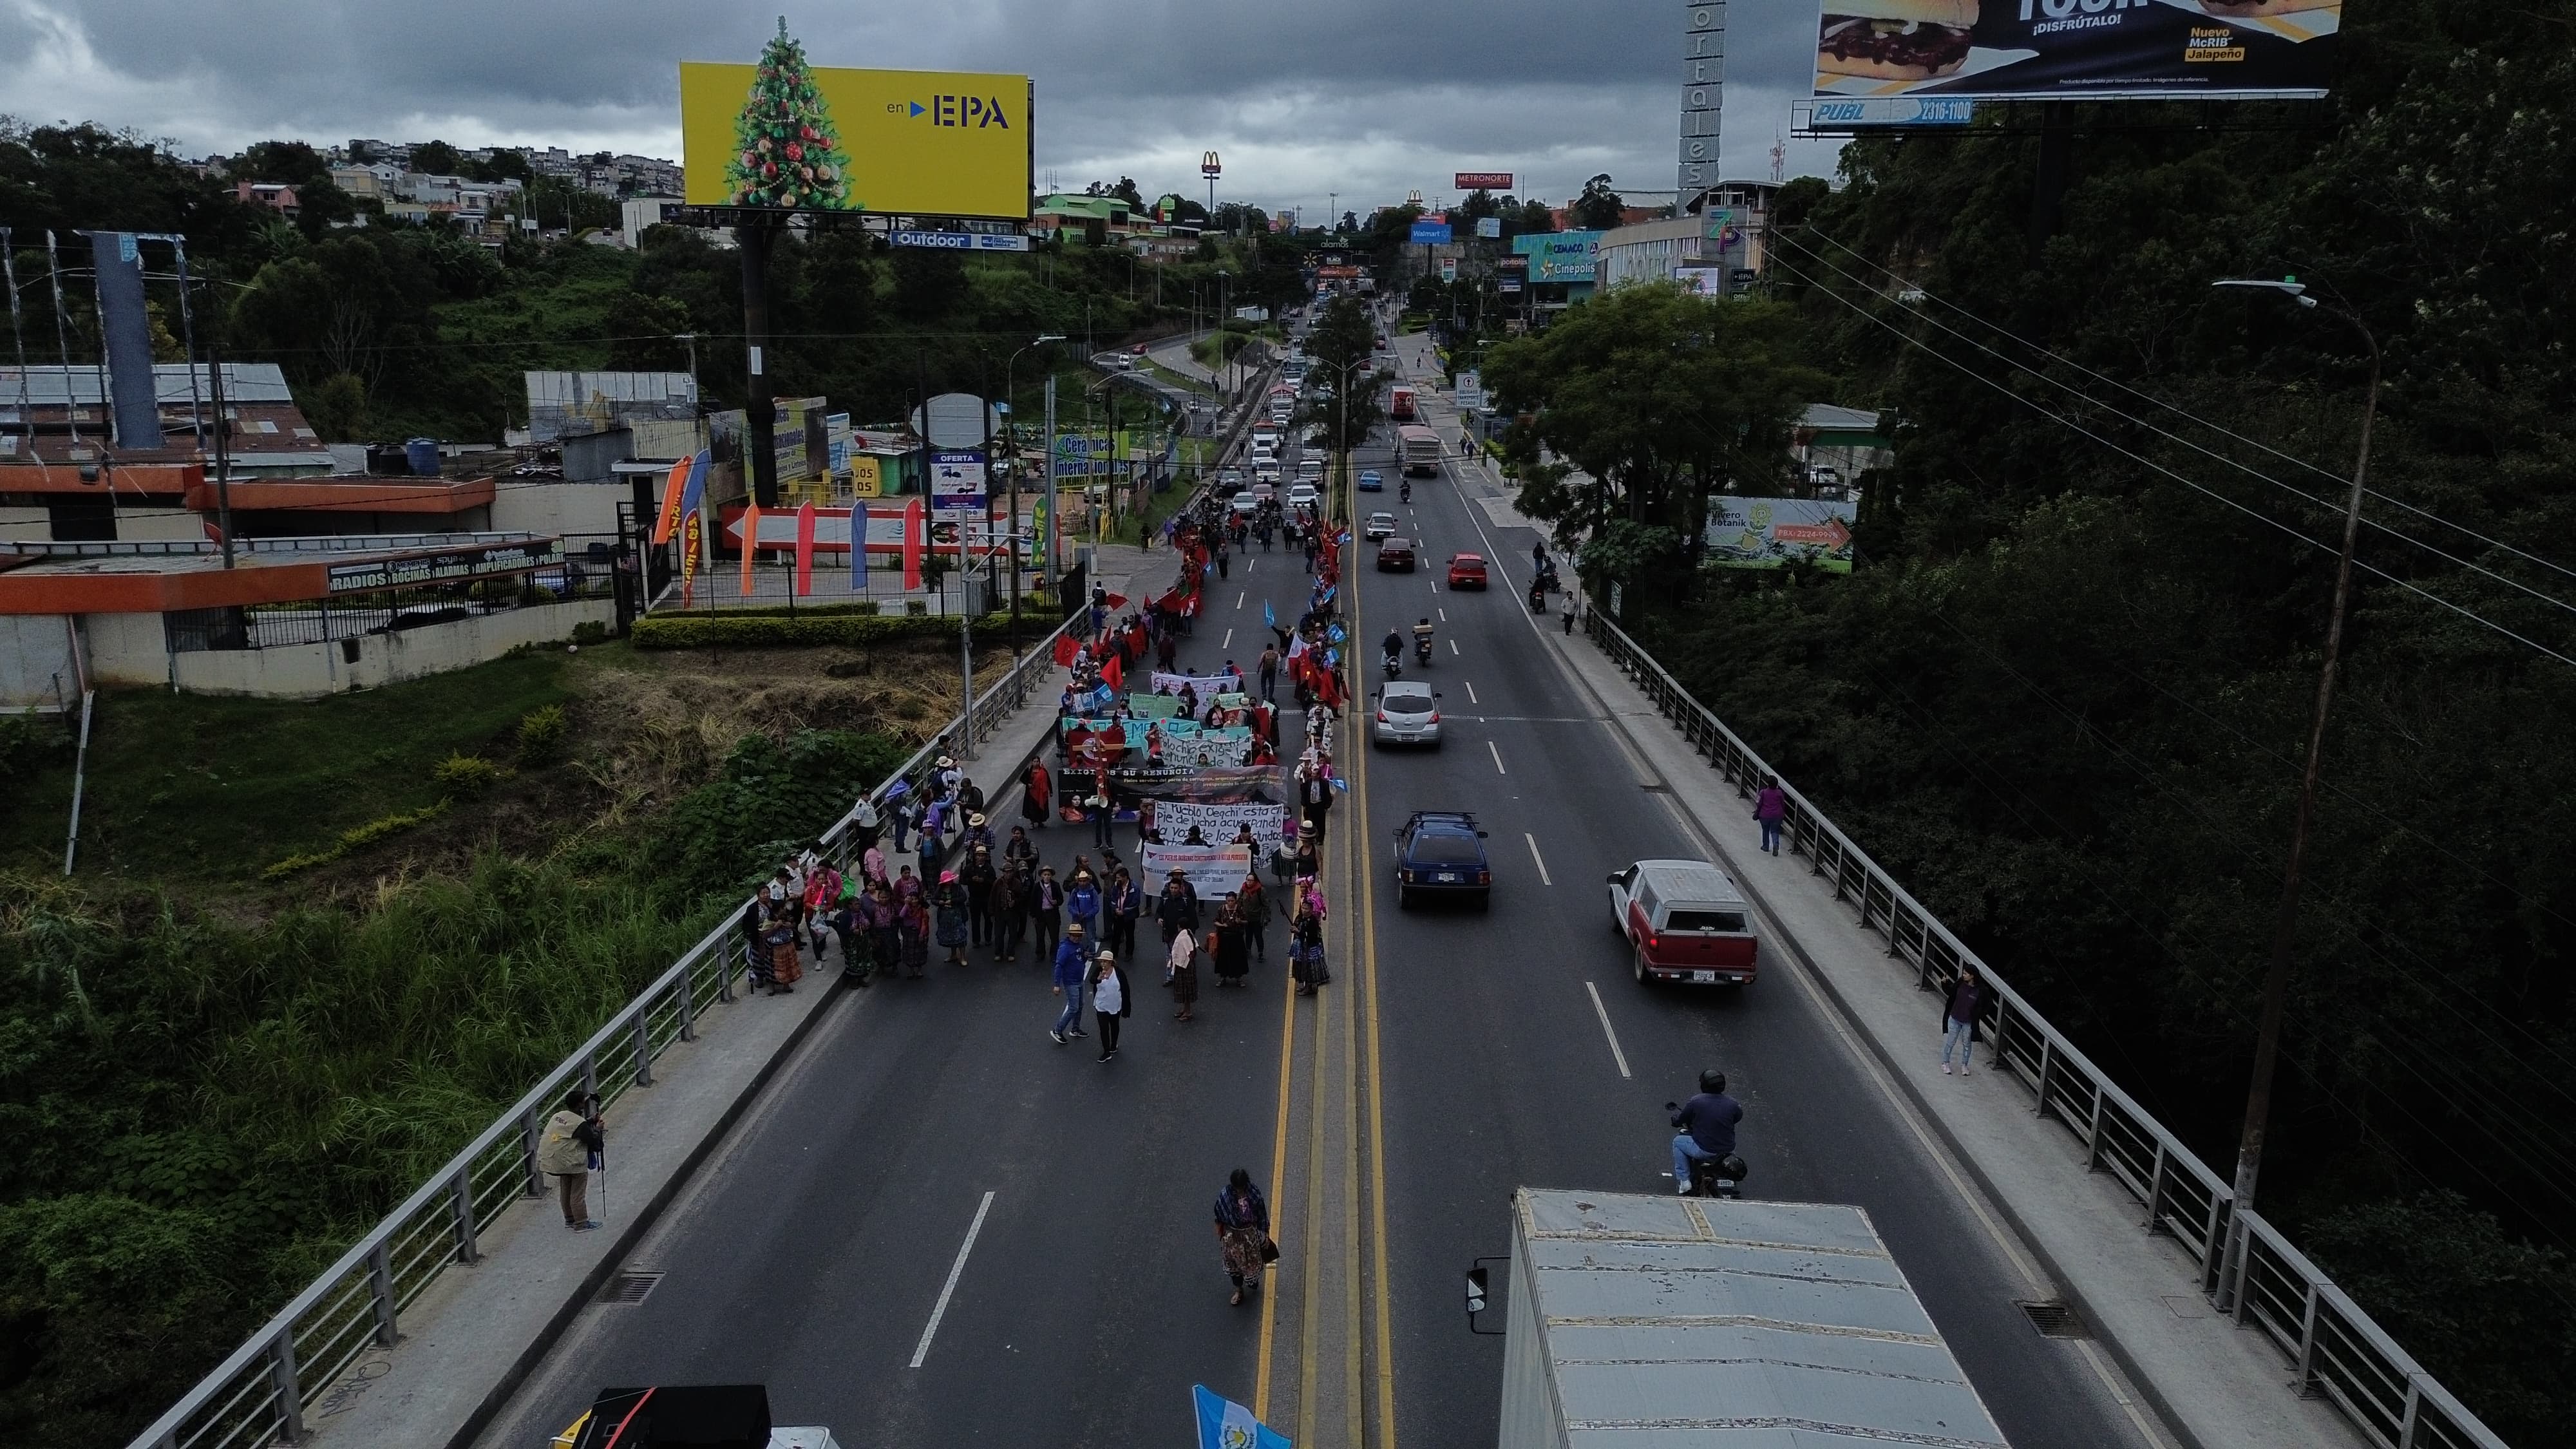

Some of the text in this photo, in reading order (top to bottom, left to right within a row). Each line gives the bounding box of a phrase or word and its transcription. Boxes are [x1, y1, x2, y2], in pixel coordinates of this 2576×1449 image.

[2032, 13, 2122, 36] ¡DISFRÚTALO!
[2190, 27, 2230, 37] Nuevo
[2189, 37, 2228, 48] McRIB
[2188, 49, 2242, 62] Jalapeño
[1687, 0, 1710, 183] ortales
[887, 95, 1009, 129] en EPA
[1922, 102, 1971, 120] 2316-1100
[900, 232, 965, 247] Outdoor
[1320, 238, 1349, 249] alamos
[1553, 243, 1584, 254] CEMACO
[1555, 261, 1595, 276] Cinépolis
[1710, 509, 1741, 518] Vivero
[332, 573, 387, 591] RADIOS
[392, 568, 431, 584] BOCINAS
[435, 564, 469, 578] ALARMAS
[475, 556, 535, 574] AMPLIFICADORES
[1142, 768, 1194, 776] RENUNCIA
[1157, 802, 1167, 810] El
[1172, 803, 1202, 817] Pueblo
[1271, 806, 1282, 815] en
[1176, 815, 1189, 824] de
[1191, 816, 1217, 827] lucha
[1215, 829, 1235, 842] los
